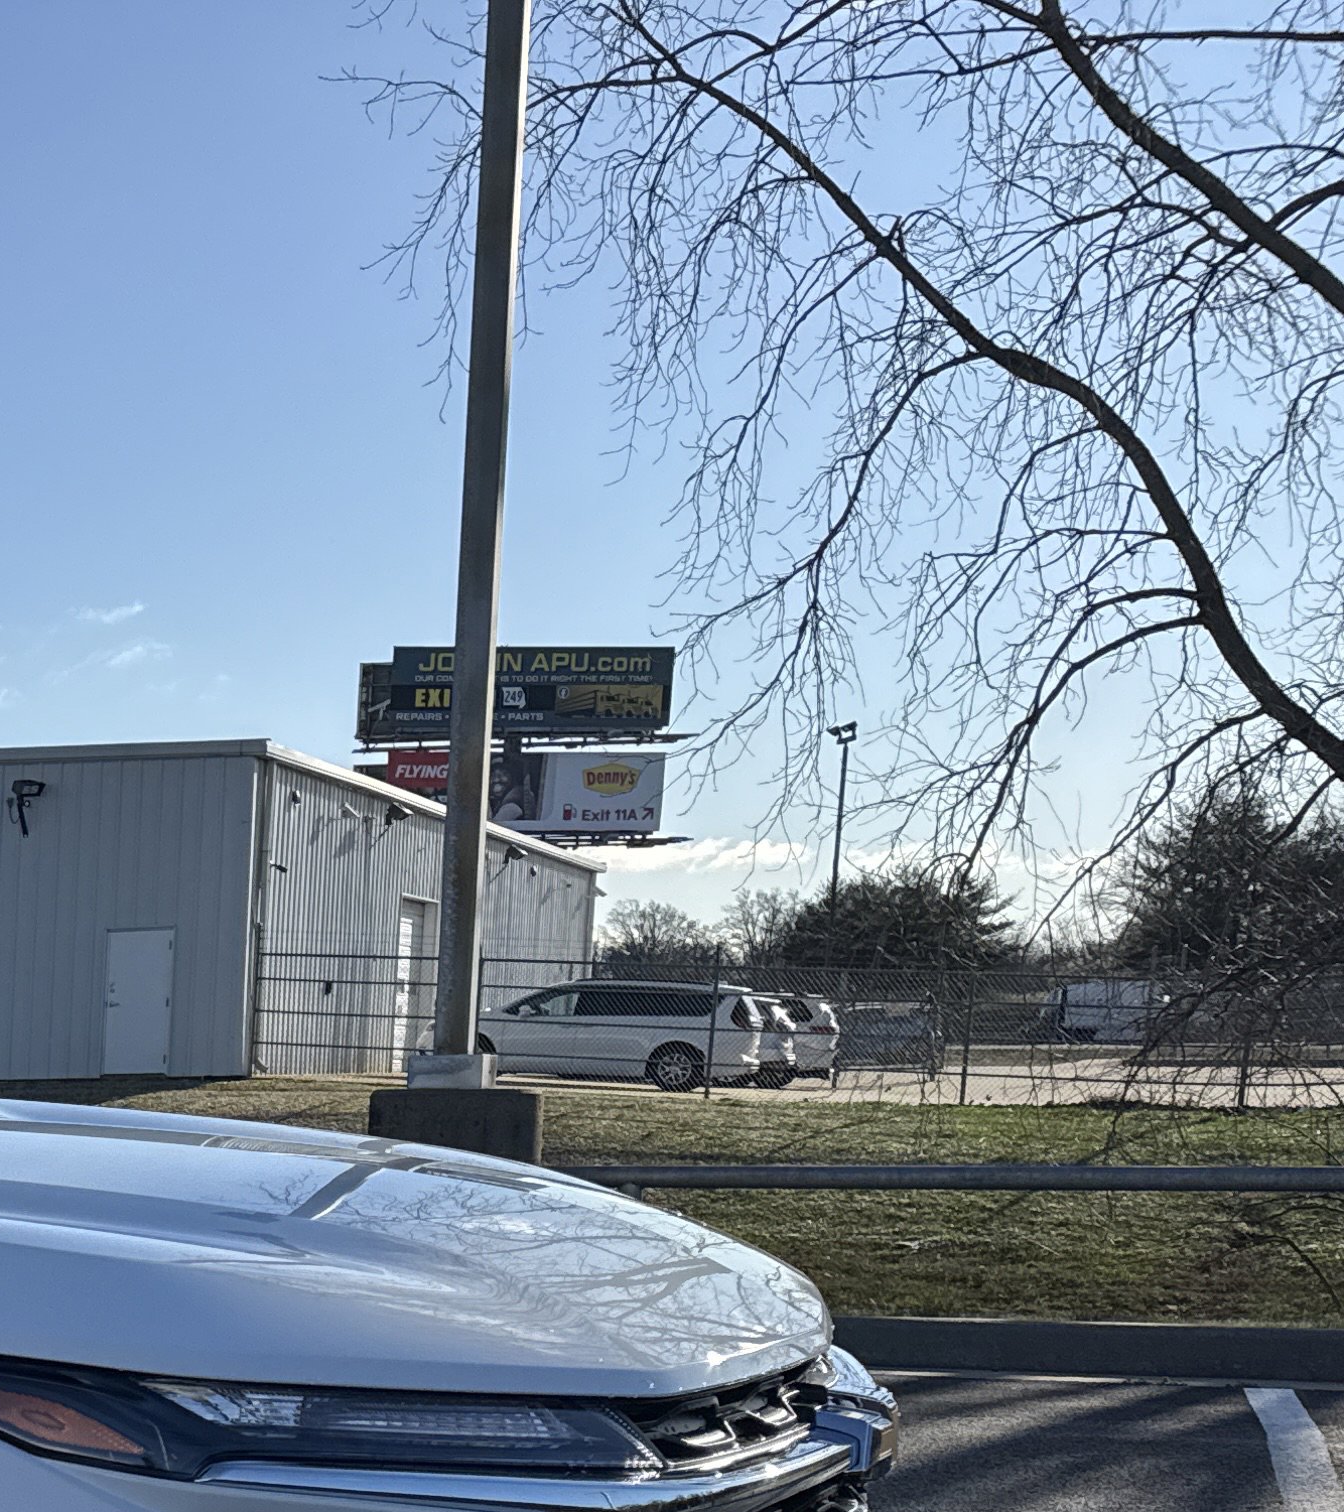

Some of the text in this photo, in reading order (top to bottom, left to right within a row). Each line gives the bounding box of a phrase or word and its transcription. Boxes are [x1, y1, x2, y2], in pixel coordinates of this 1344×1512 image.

[530, 652, 652, 672] APU.com
[415, 688, 523, 708] EXI 249
[396, 712, 442, 720] REPAIRS
[395, 764, 449, 778] FLYING
[586, 770, 636, 786] Denny's
[582, 809, 638, 821] Exit 11A
